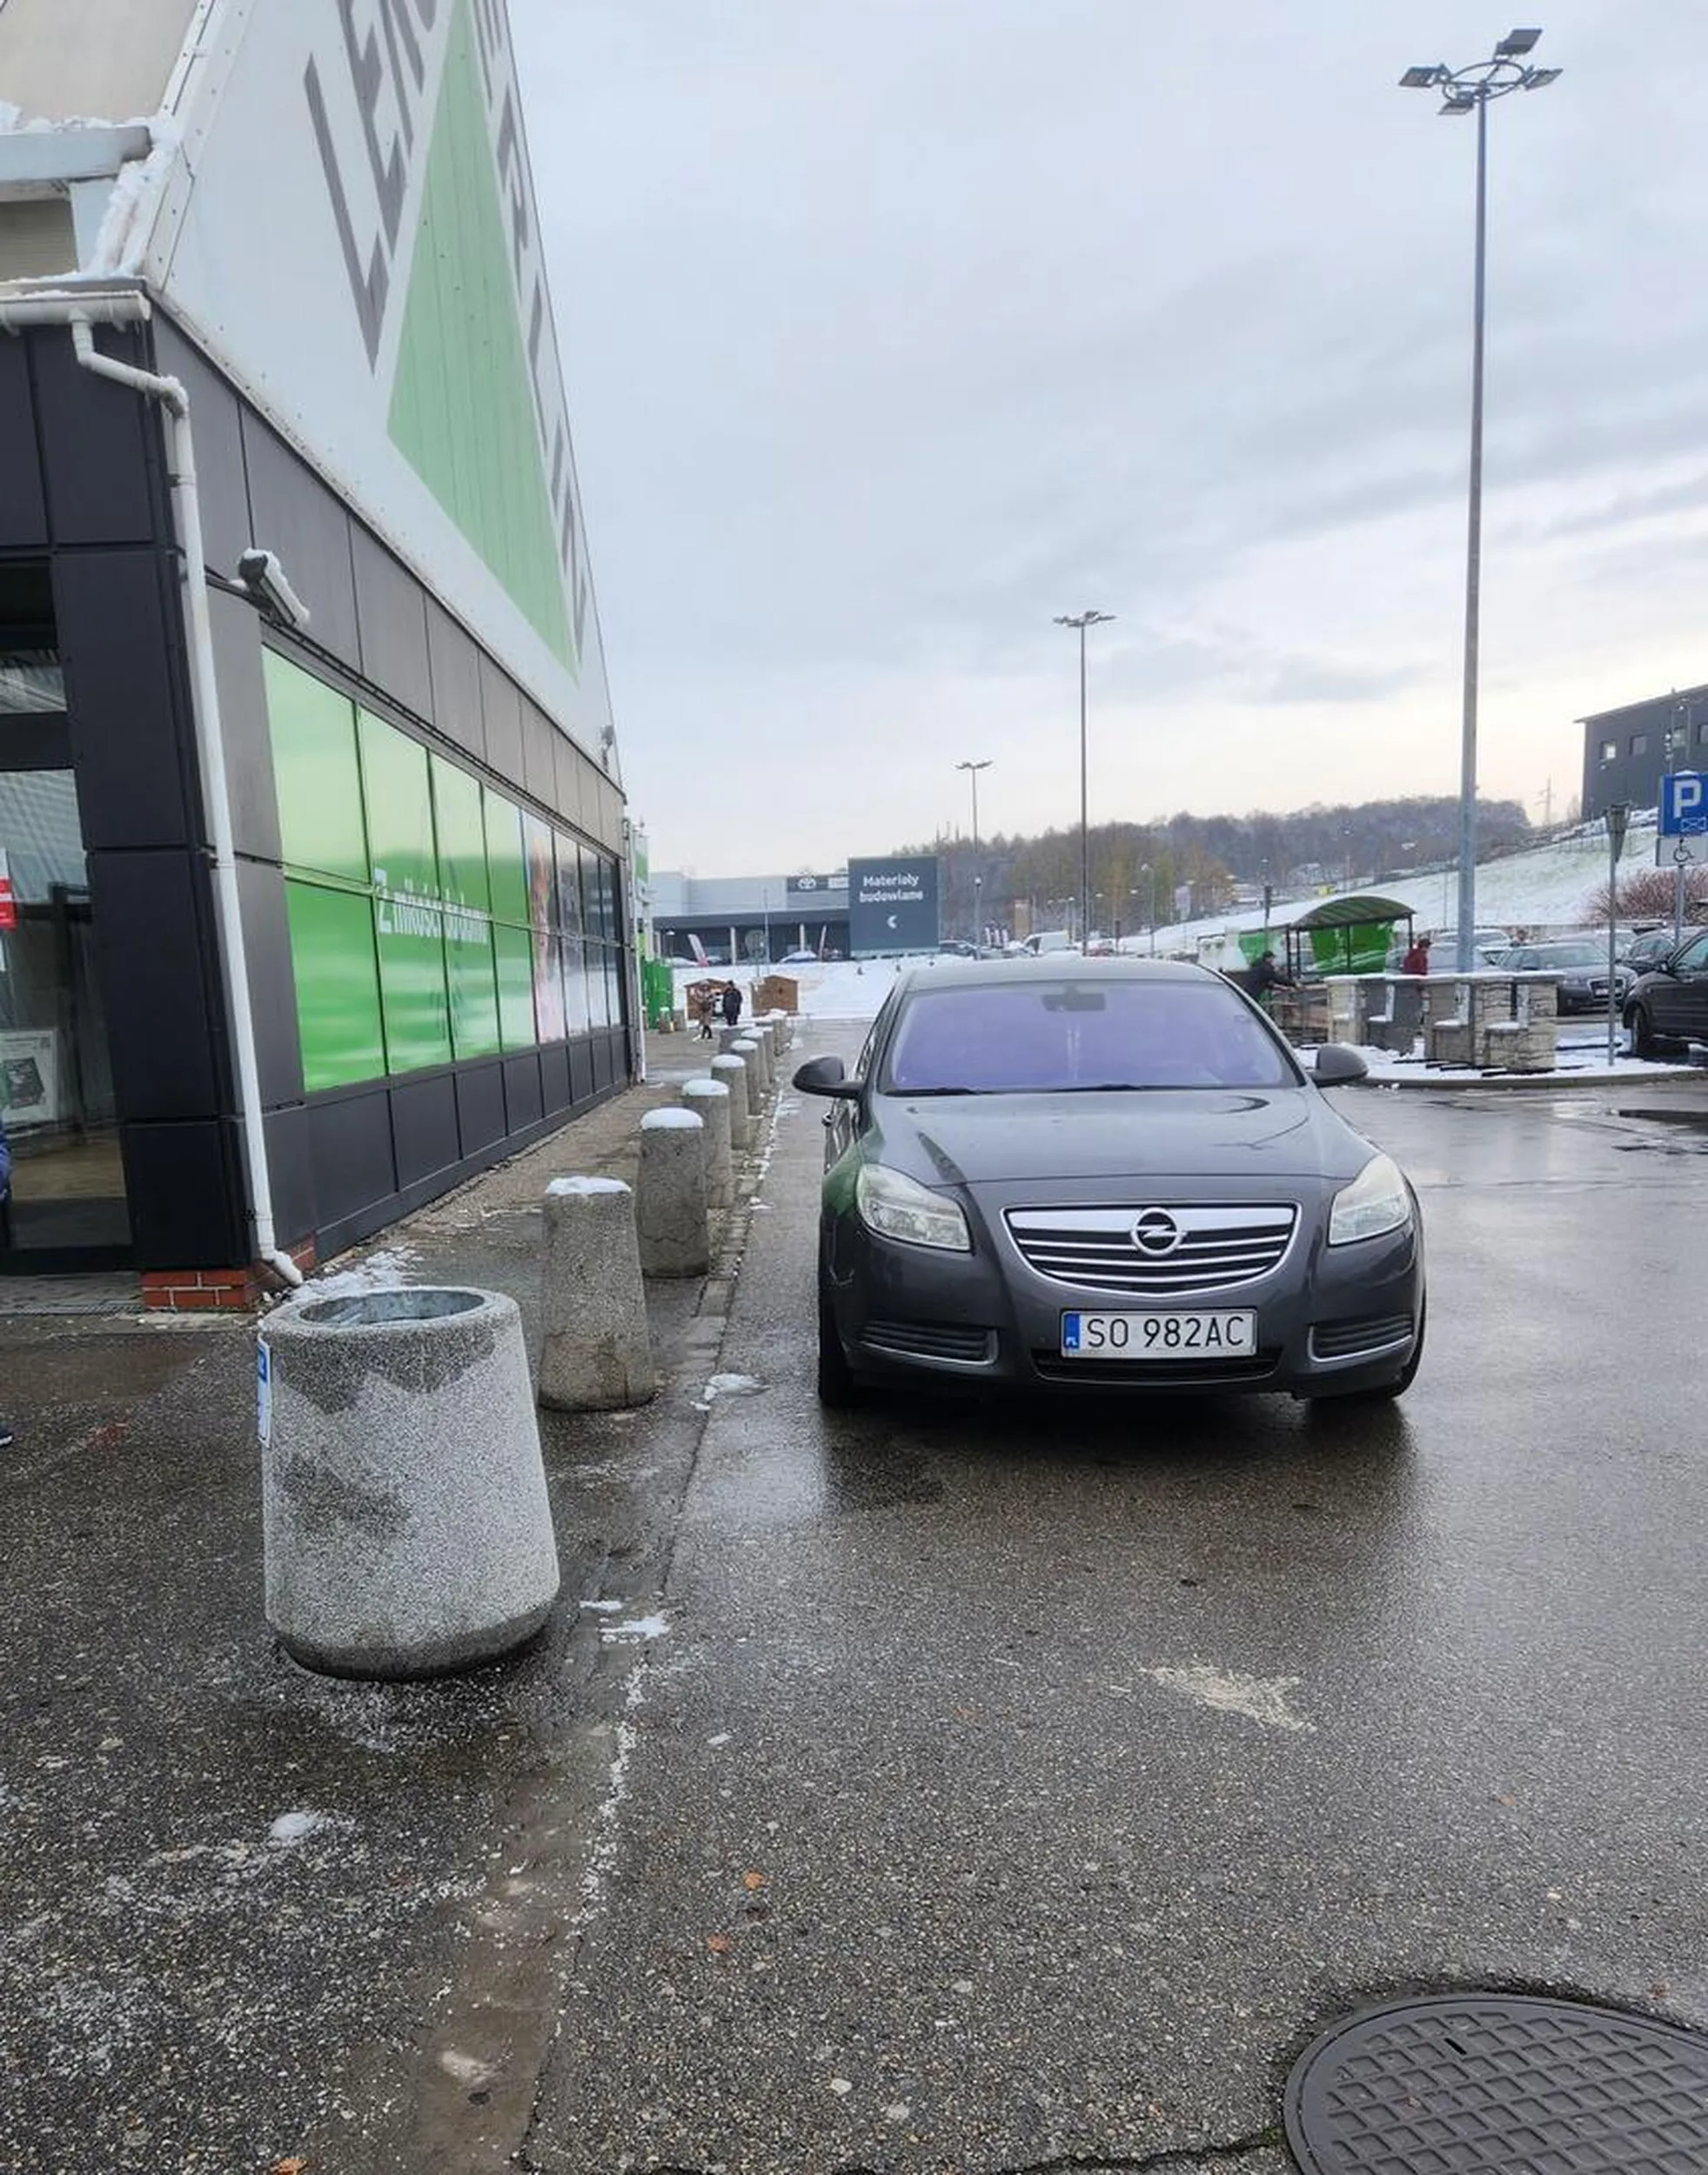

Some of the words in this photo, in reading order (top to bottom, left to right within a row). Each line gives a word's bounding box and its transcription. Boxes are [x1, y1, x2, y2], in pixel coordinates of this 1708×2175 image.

[1673, 780, 1702, 819] P
[1087, 1318, 1129, 1348] SO
[1143, 1316, 1244, 1348] 982AC
